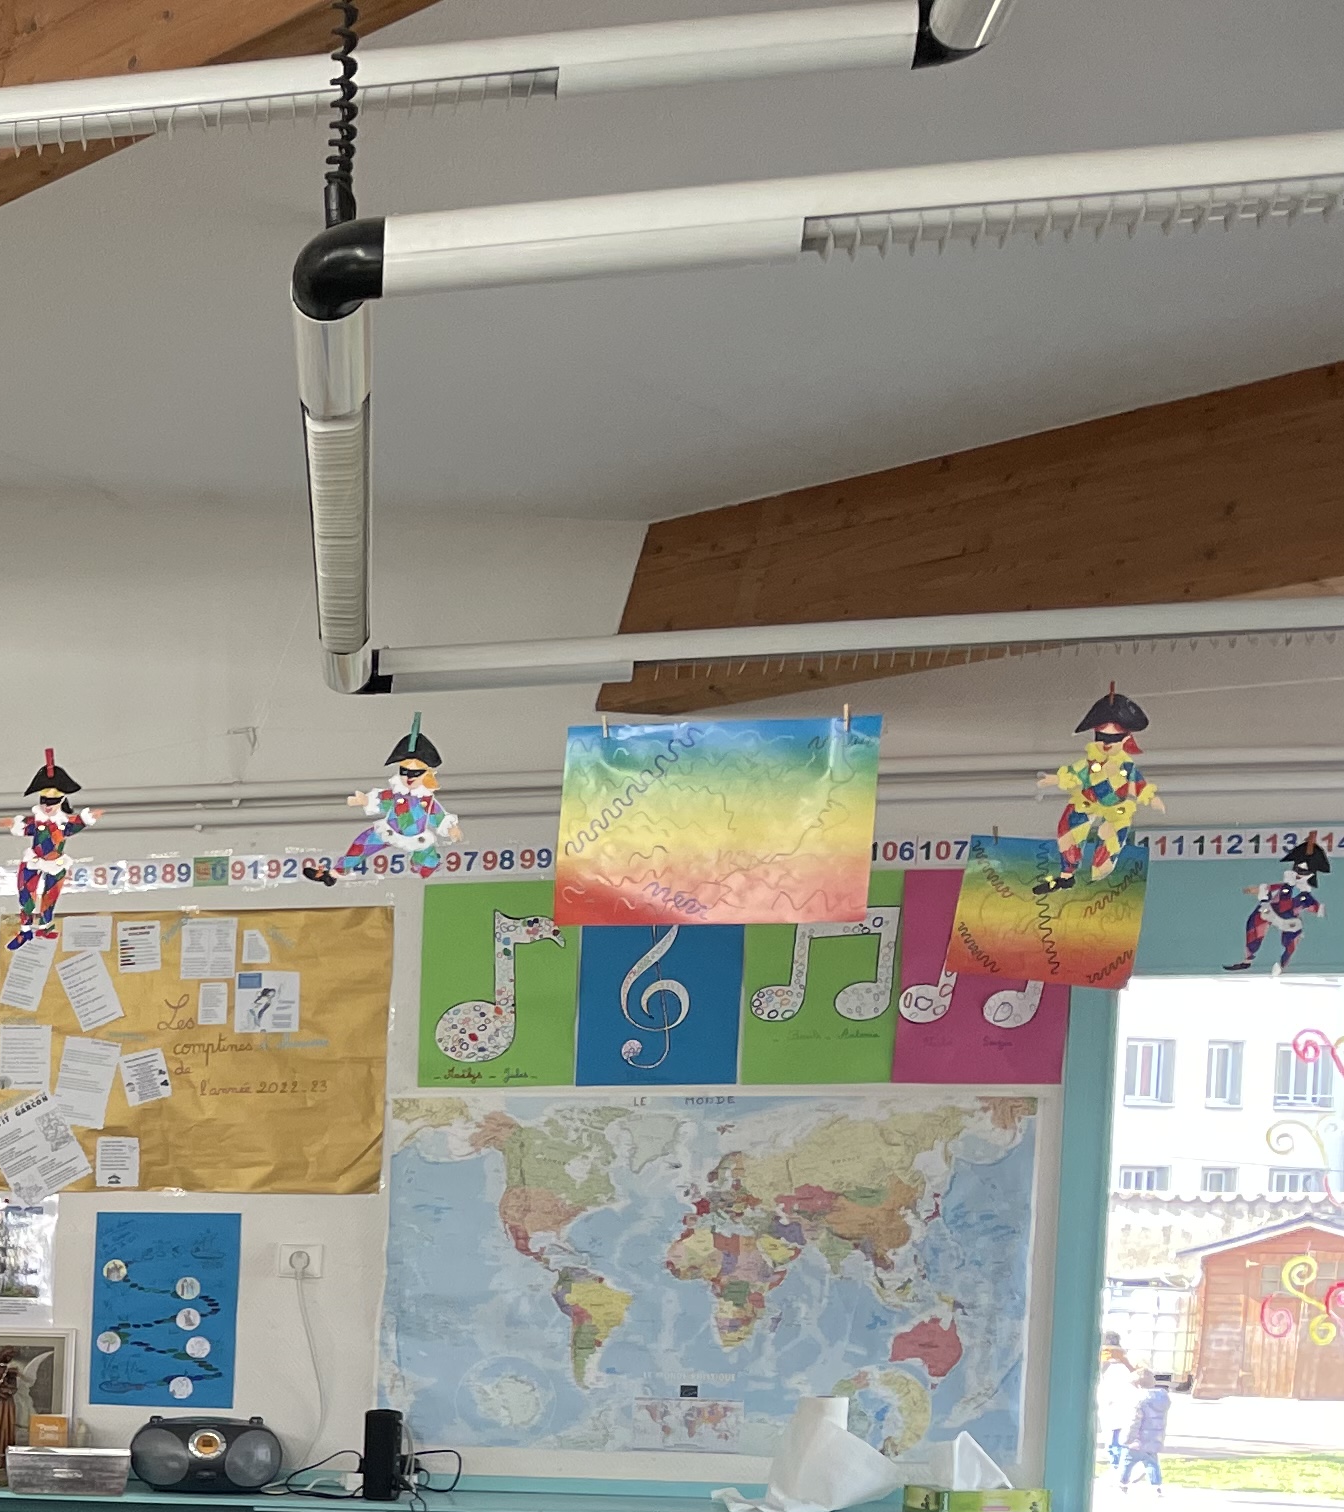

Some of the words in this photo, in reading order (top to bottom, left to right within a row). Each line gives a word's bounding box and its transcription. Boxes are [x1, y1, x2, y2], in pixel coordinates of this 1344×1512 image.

[447, 851, 477, 872] 97
[482, 850, 514, 871] 98
[519, 848, 551, 869] 99
[919, 840, 968, 860] 107
[1194, 834, 1242, 856] 112
[156, 993, 195, 1031] Les
[173, 1032, 253, 1066] comptines
